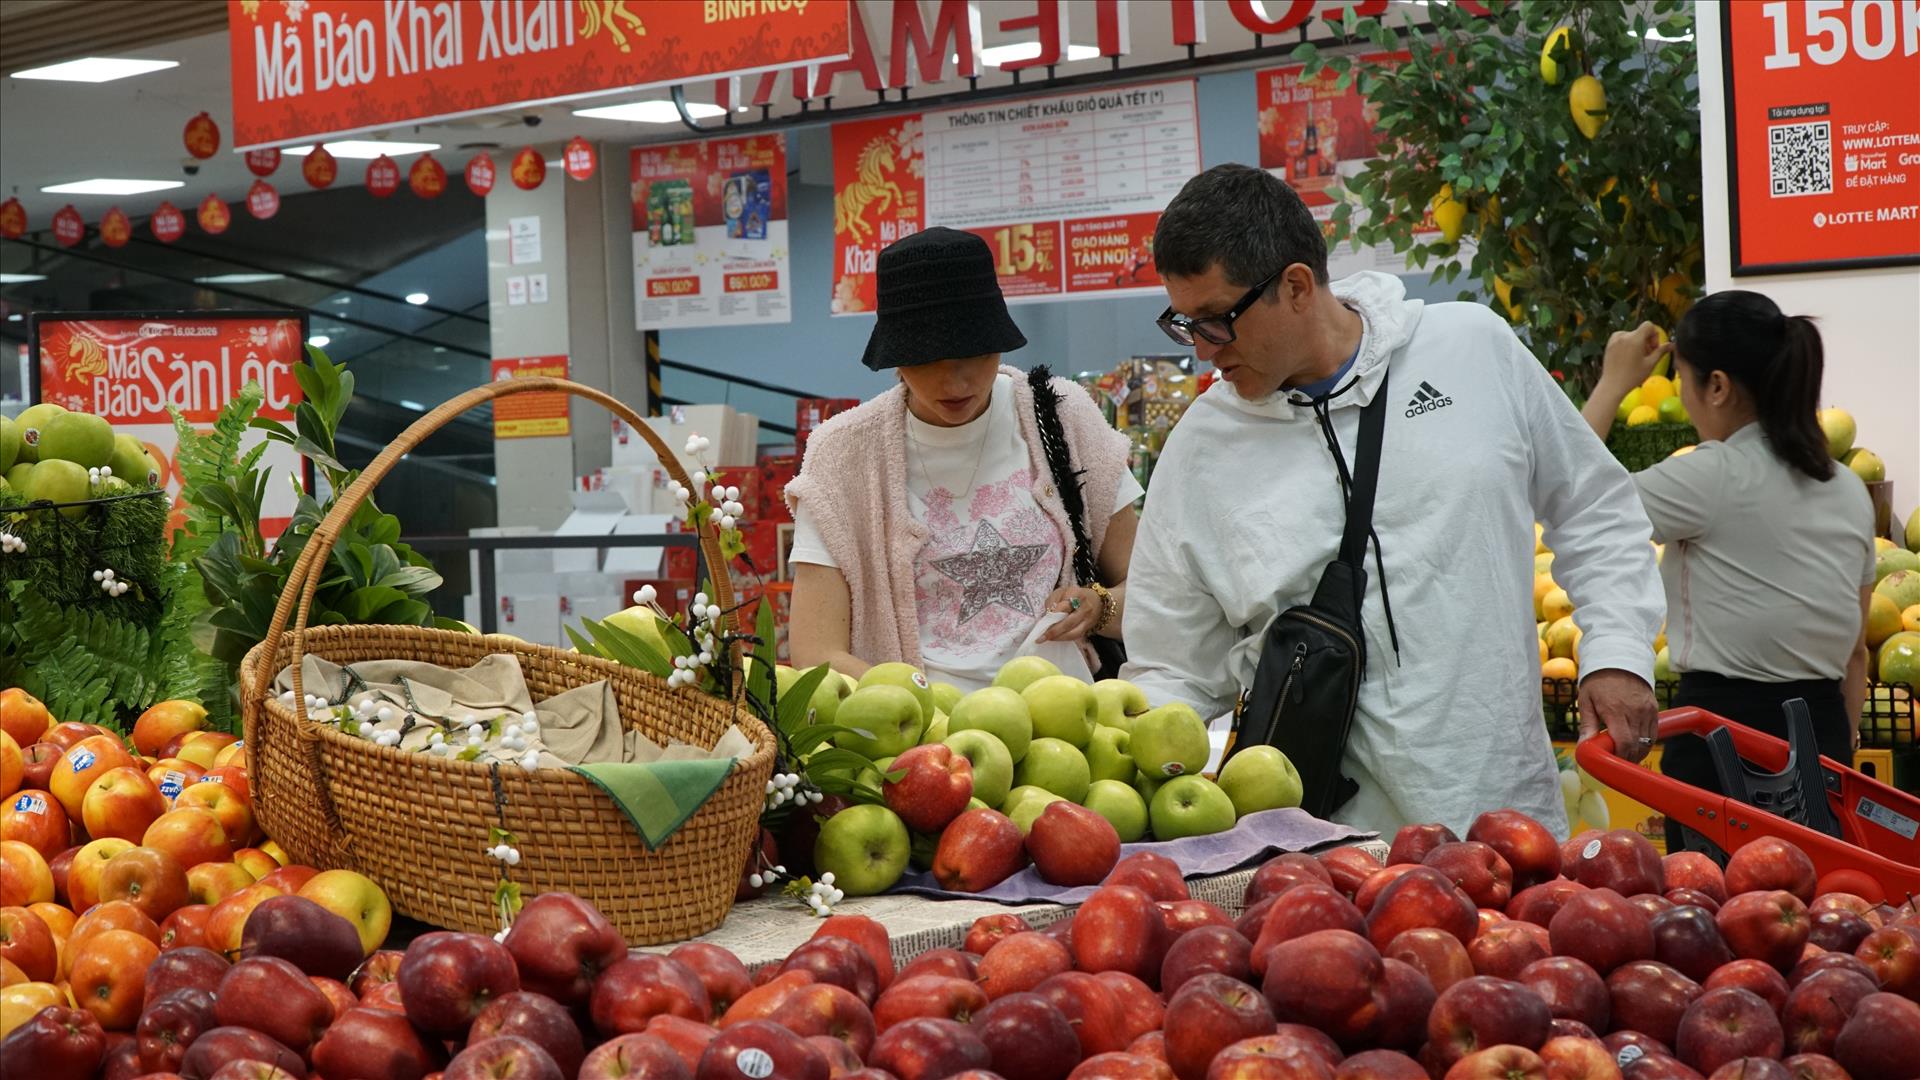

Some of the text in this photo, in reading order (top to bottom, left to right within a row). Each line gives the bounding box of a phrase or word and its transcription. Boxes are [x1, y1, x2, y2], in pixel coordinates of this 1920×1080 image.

[255, 21, 304, 102] Mã
[312, 11, 376, 92] Đáo
[947, 112, 986, 129] THÔNG
[988, 110, 1006, 122] TIN
[1842, 120, 1890, 135] TRUY CẬP:
[1843, 133, 1920, 150] WWW.LOTTEM
[1860, 158, 1887, 170] Mart
[1880, 172, 1906, 185] HÀNG
[1829, 205, 1918, 225] LOTTE MART
[1071, 232, 1129, 249] GIAO HÀNG
[844, 242, 877, 274] Khai
[108, 345, 140, 380] Mã
[141, 347, 217, 413] Săn
[94, 376, 141, 417] Đáo
[1405, 396, 1453, 418] adidas
